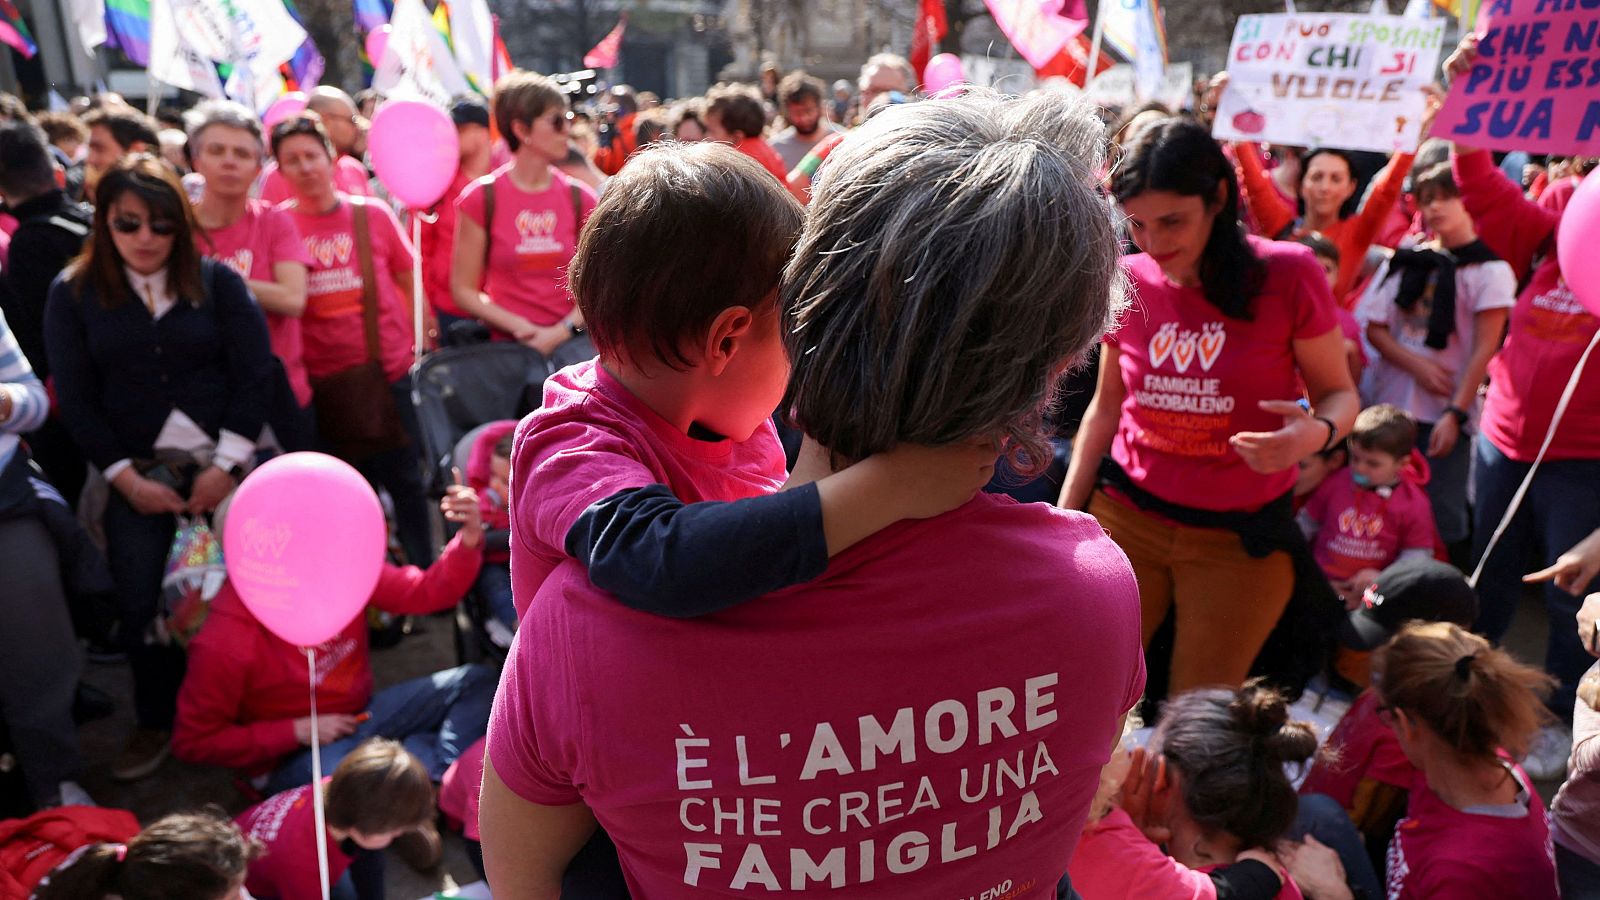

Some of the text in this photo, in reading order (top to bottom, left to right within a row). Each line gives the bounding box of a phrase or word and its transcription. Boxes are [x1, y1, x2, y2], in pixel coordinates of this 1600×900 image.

[1234, 41, 1296, 62] CON
[1306, 47, 1362, 68] CHI
[1478, 20, 1600, 58] CHE N
[1272, 73, 1404, 101] VUOLE
[1453, 97, 1553, 139] SUA
[1143, 374, 1221, 396] FAMIGLIE
[675, 724, 713, 790] È
[679, 741, 1060, 836] CHE CREA UNA
[683, 790, 1044, 891] FAMIGLIA
